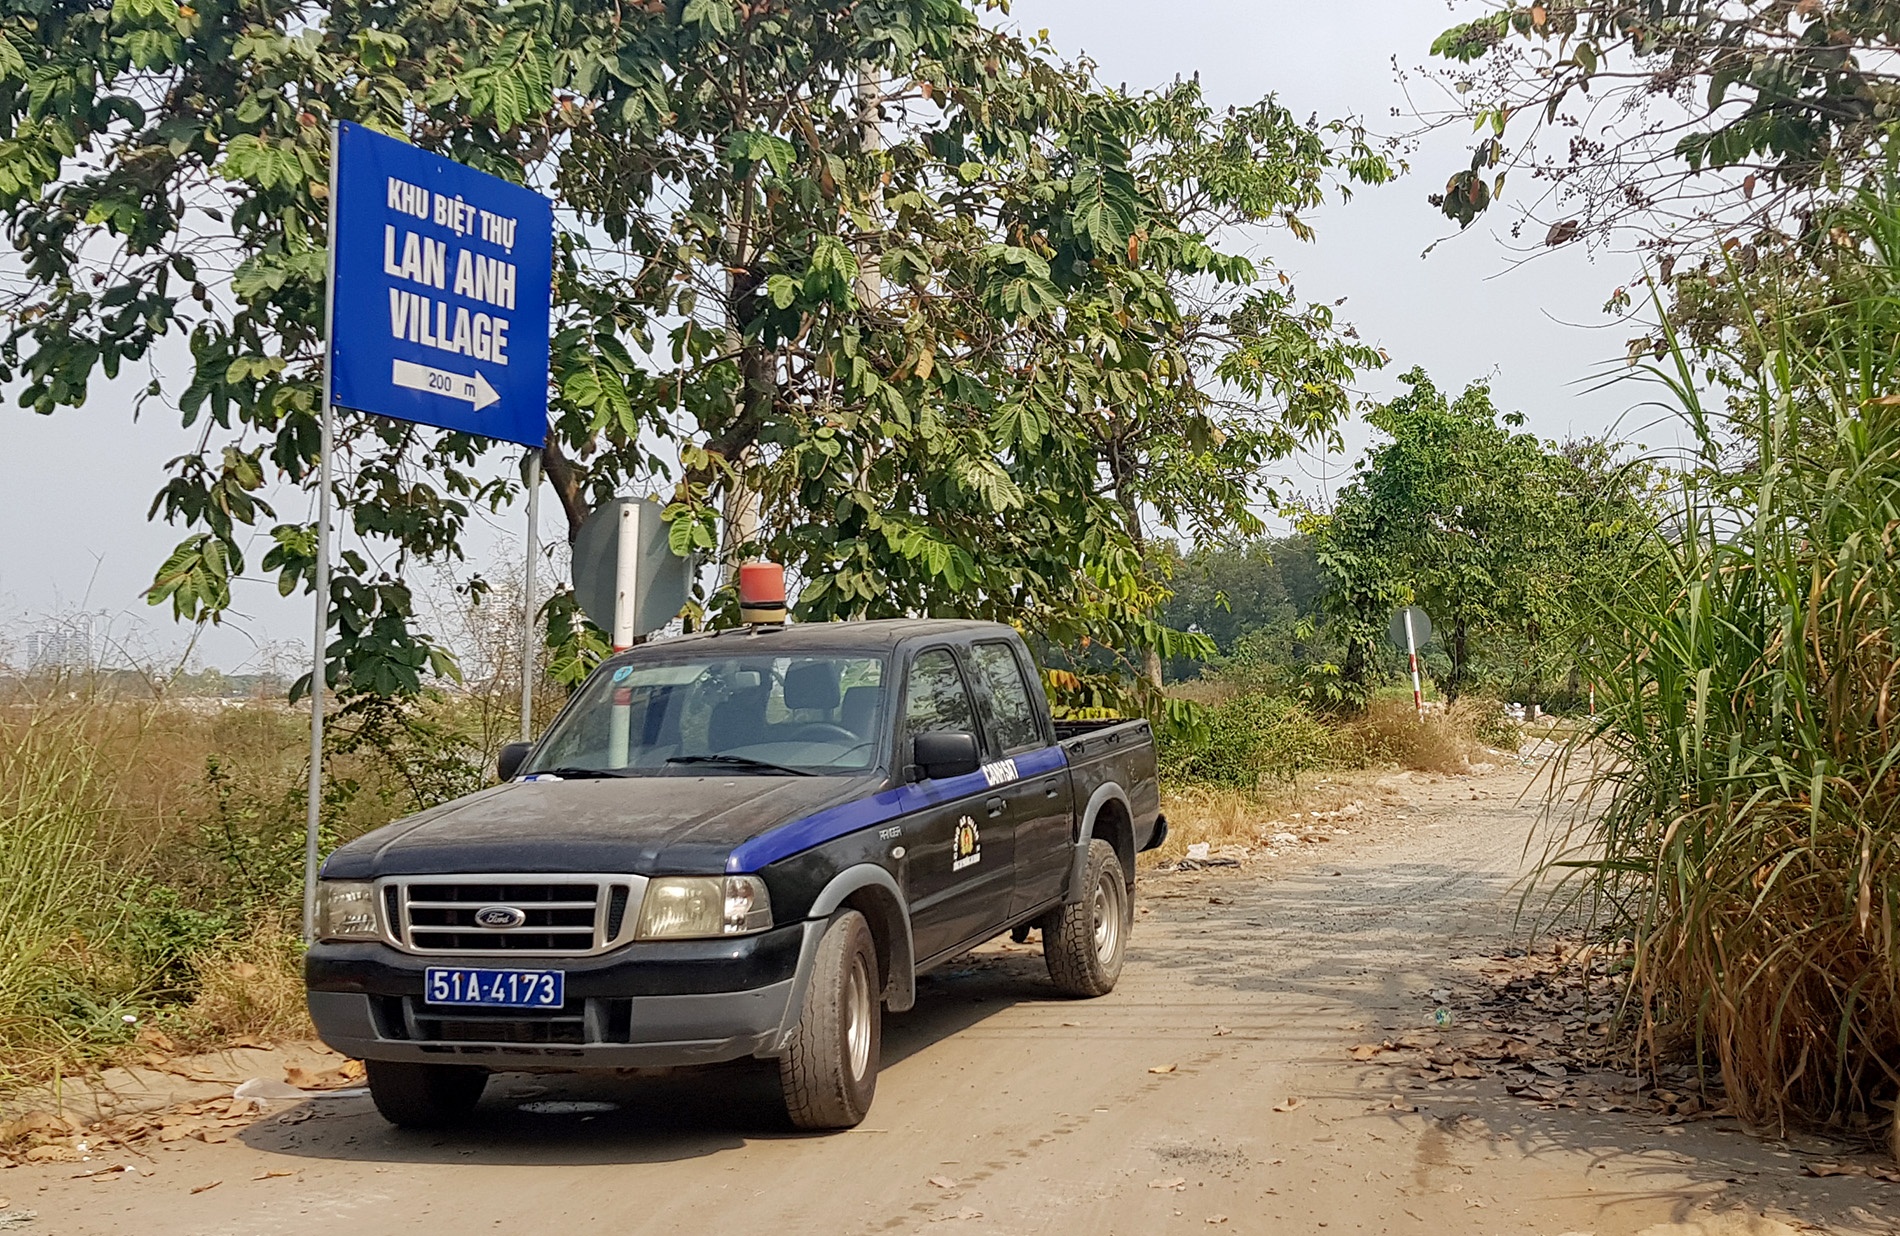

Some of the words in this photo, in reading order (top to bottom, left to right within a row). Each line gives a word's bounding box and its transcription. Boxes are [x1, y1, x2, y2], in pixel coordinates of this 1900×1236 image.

[387, 176, 429, 220] KHU
[433, 193, 476, 238] BIỆT
[480, 209, 517, 255] THỰ
[384, 223, 447, 290] LAN
[453, 248, 516, 311] ANH
[389, 286, 509, 366] VILLAGE
[428, 371, 452, 392] 200
[464, 382, 476, 397] m
[486, 912, 510, 923] Ford
[433, 971, 555, 1004] 51A-4173
